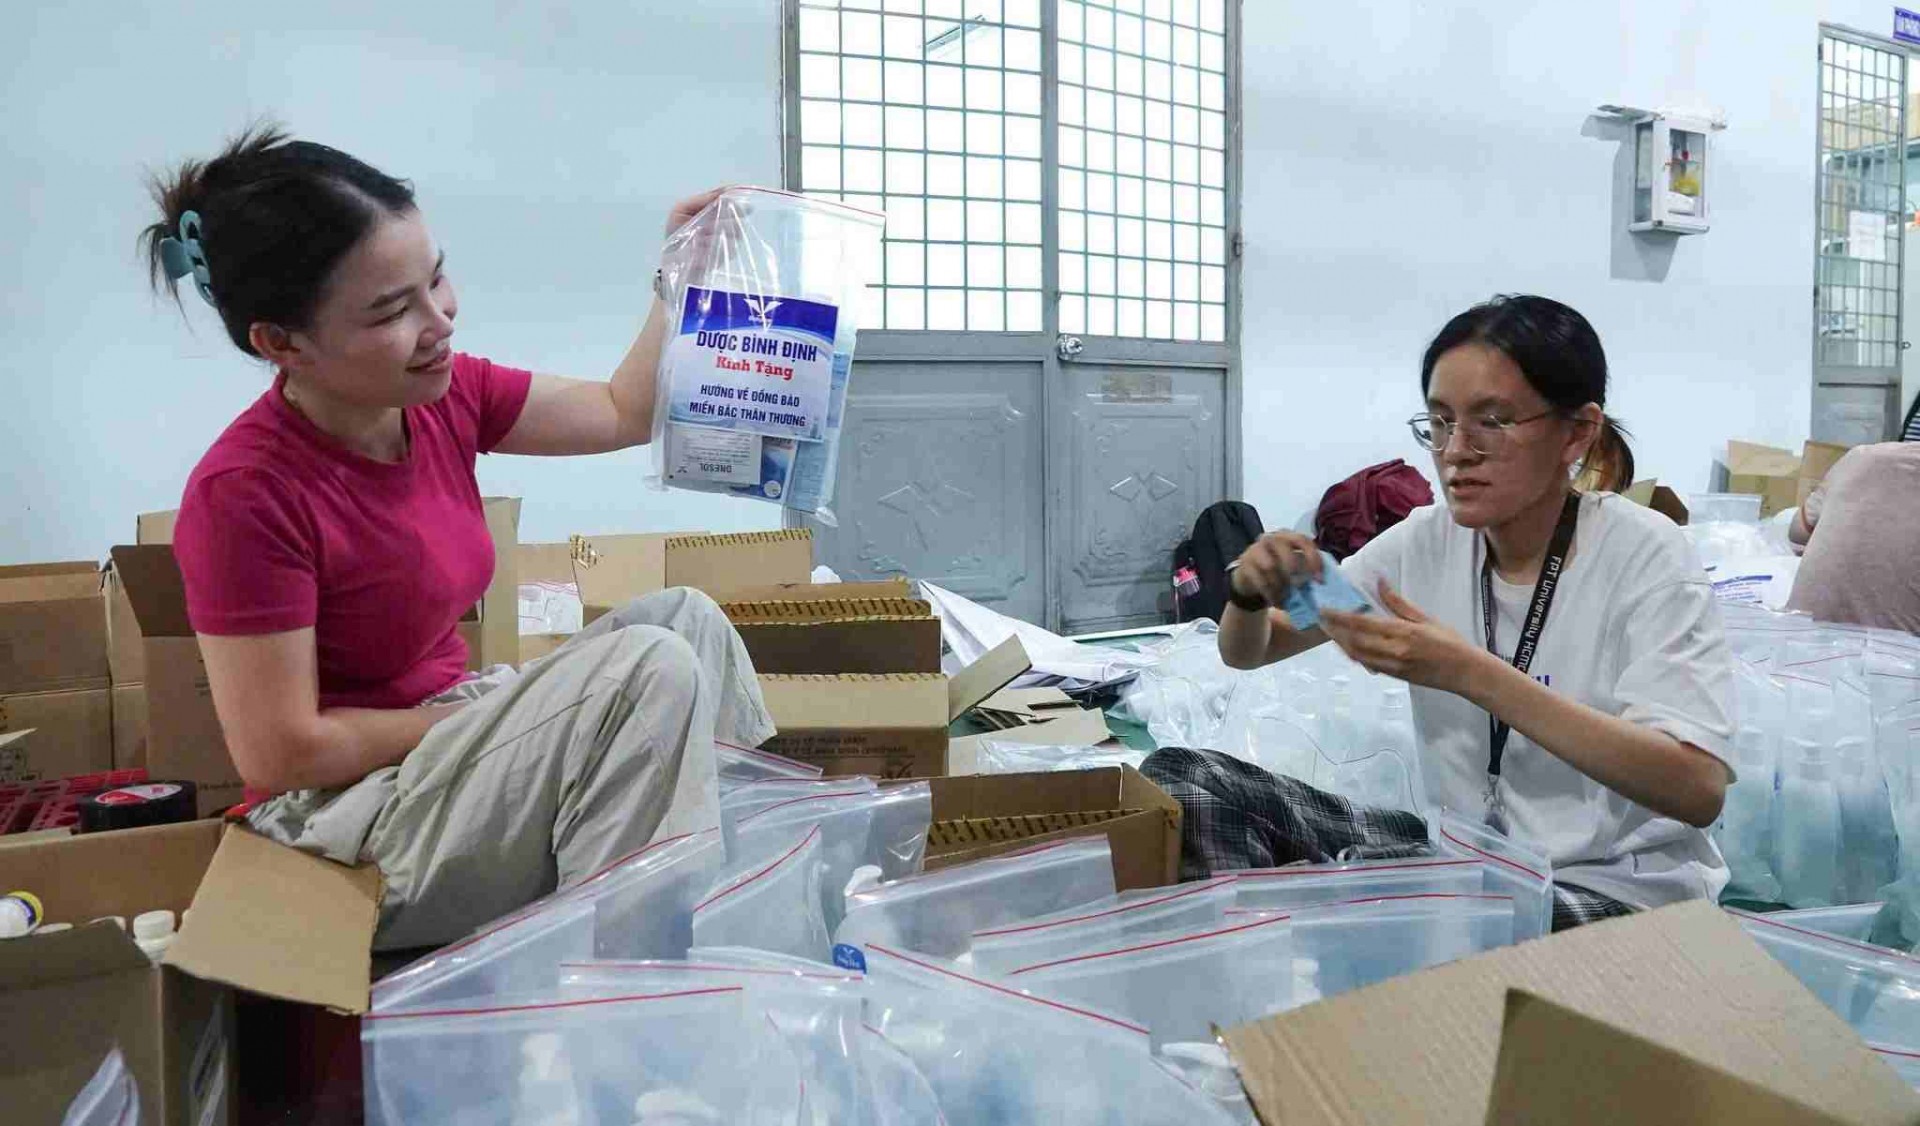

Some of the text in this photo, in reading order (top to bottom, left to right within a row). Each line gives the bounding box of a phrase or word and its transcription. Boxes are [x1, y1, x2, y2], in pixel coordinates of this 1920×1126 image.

[696, 331, 737, 354] DƯỢC
[782, 341, 817, 362] ĐỊNH
[1547, 555, 1562, 577] FPT
[1525, 579, 1554, 639] University
